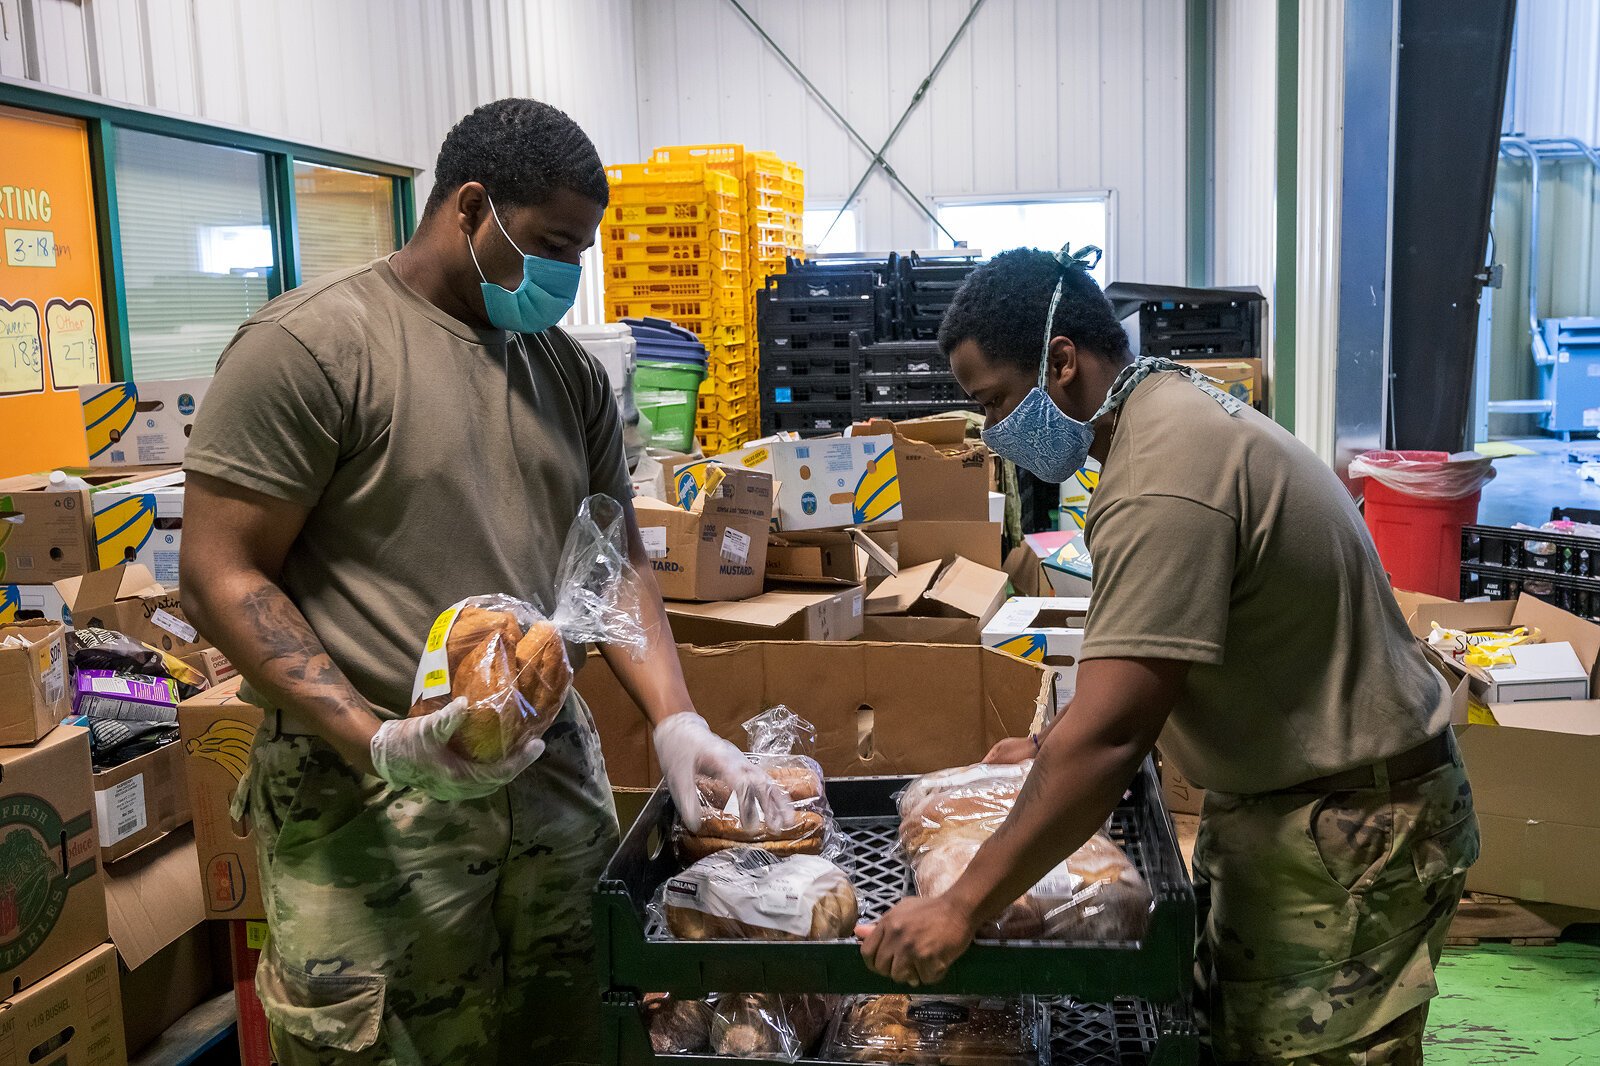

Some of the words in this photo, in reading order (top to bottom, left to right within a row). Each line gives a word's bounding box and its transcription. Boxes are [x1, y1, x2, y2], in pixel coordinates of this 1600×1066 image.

[56, 314, 85, 331] Other
[12, 341, 31, 368] 18
[63, 341, 85, 369] 27
[650, 560, 679, 572] TARD
[720, 564, 753, 576] MUSTARD
[2, 804, 48, 825] FRESH
[85, 964, 106, 984] ACORN
[45, 999, 71, 1022] BUSHEL
